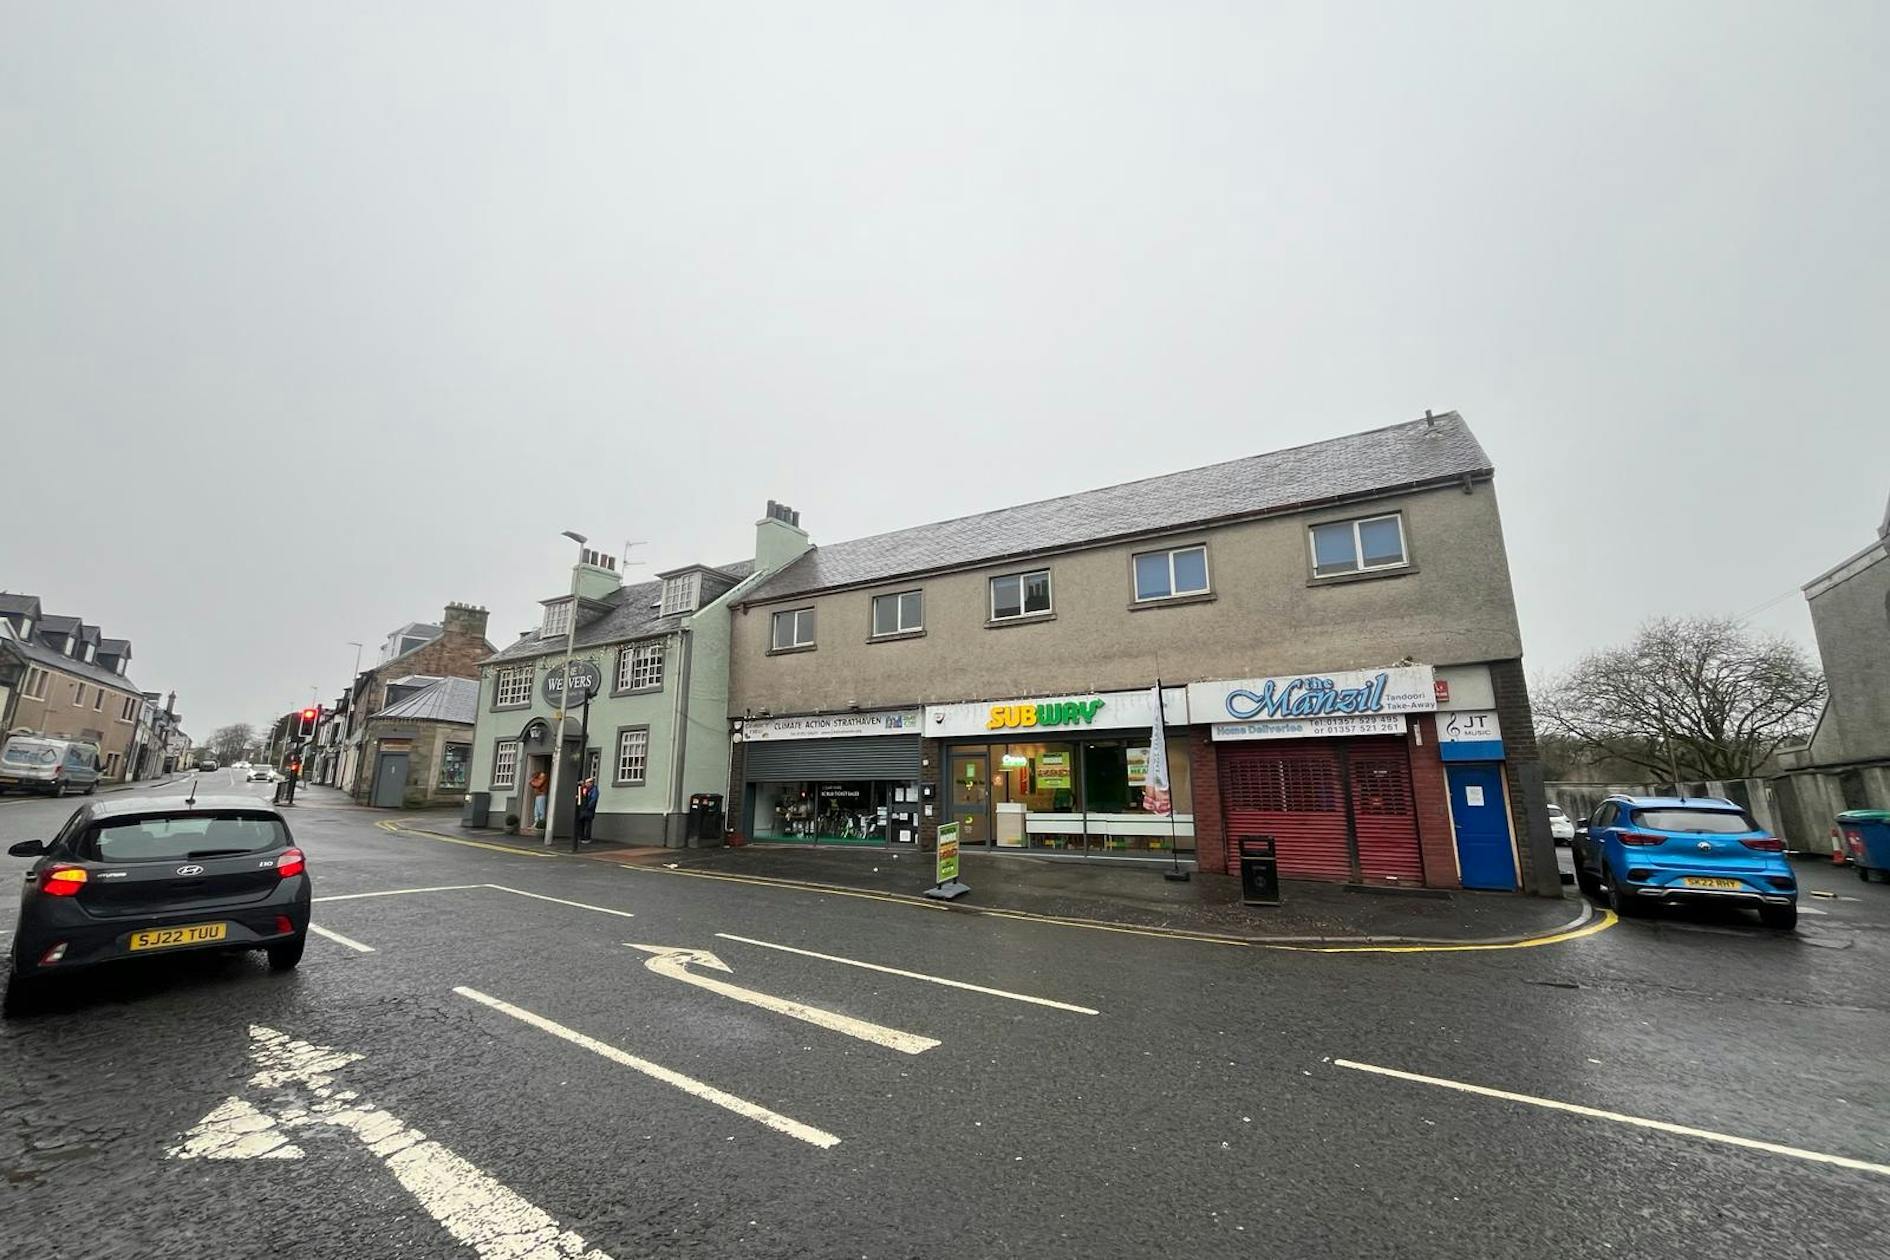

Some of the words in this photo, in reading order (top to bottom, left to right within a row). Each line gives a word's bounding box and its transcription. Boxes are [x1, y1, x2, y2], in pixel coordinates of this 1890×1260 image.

[548, 675, 592, 691] WEVERS
[1304, 677, 1334, 691] the
[1225, 672, 1389, 720] Manzil
[1386, 693, 1426, 702] Tandoori
[1387, 702, 1436, 711] Take-Away
[985, 697, 1106, 731] SUBWAY
[774, 722, 801, 730] CLIMATE
[805, 720, 831, 728] ACTION
[833, 716, 881, 727] STRATHAVEN
[1464, 715, 1487, 728] JT
[1216, 725, 1247, 736] Home
[1248, 723, 1304, 735] Deliveries
[1328, 725, 1356, 734] 01357
[139, 931, 183, 947] SJ22
[189, 926, 220, 941] TUU
